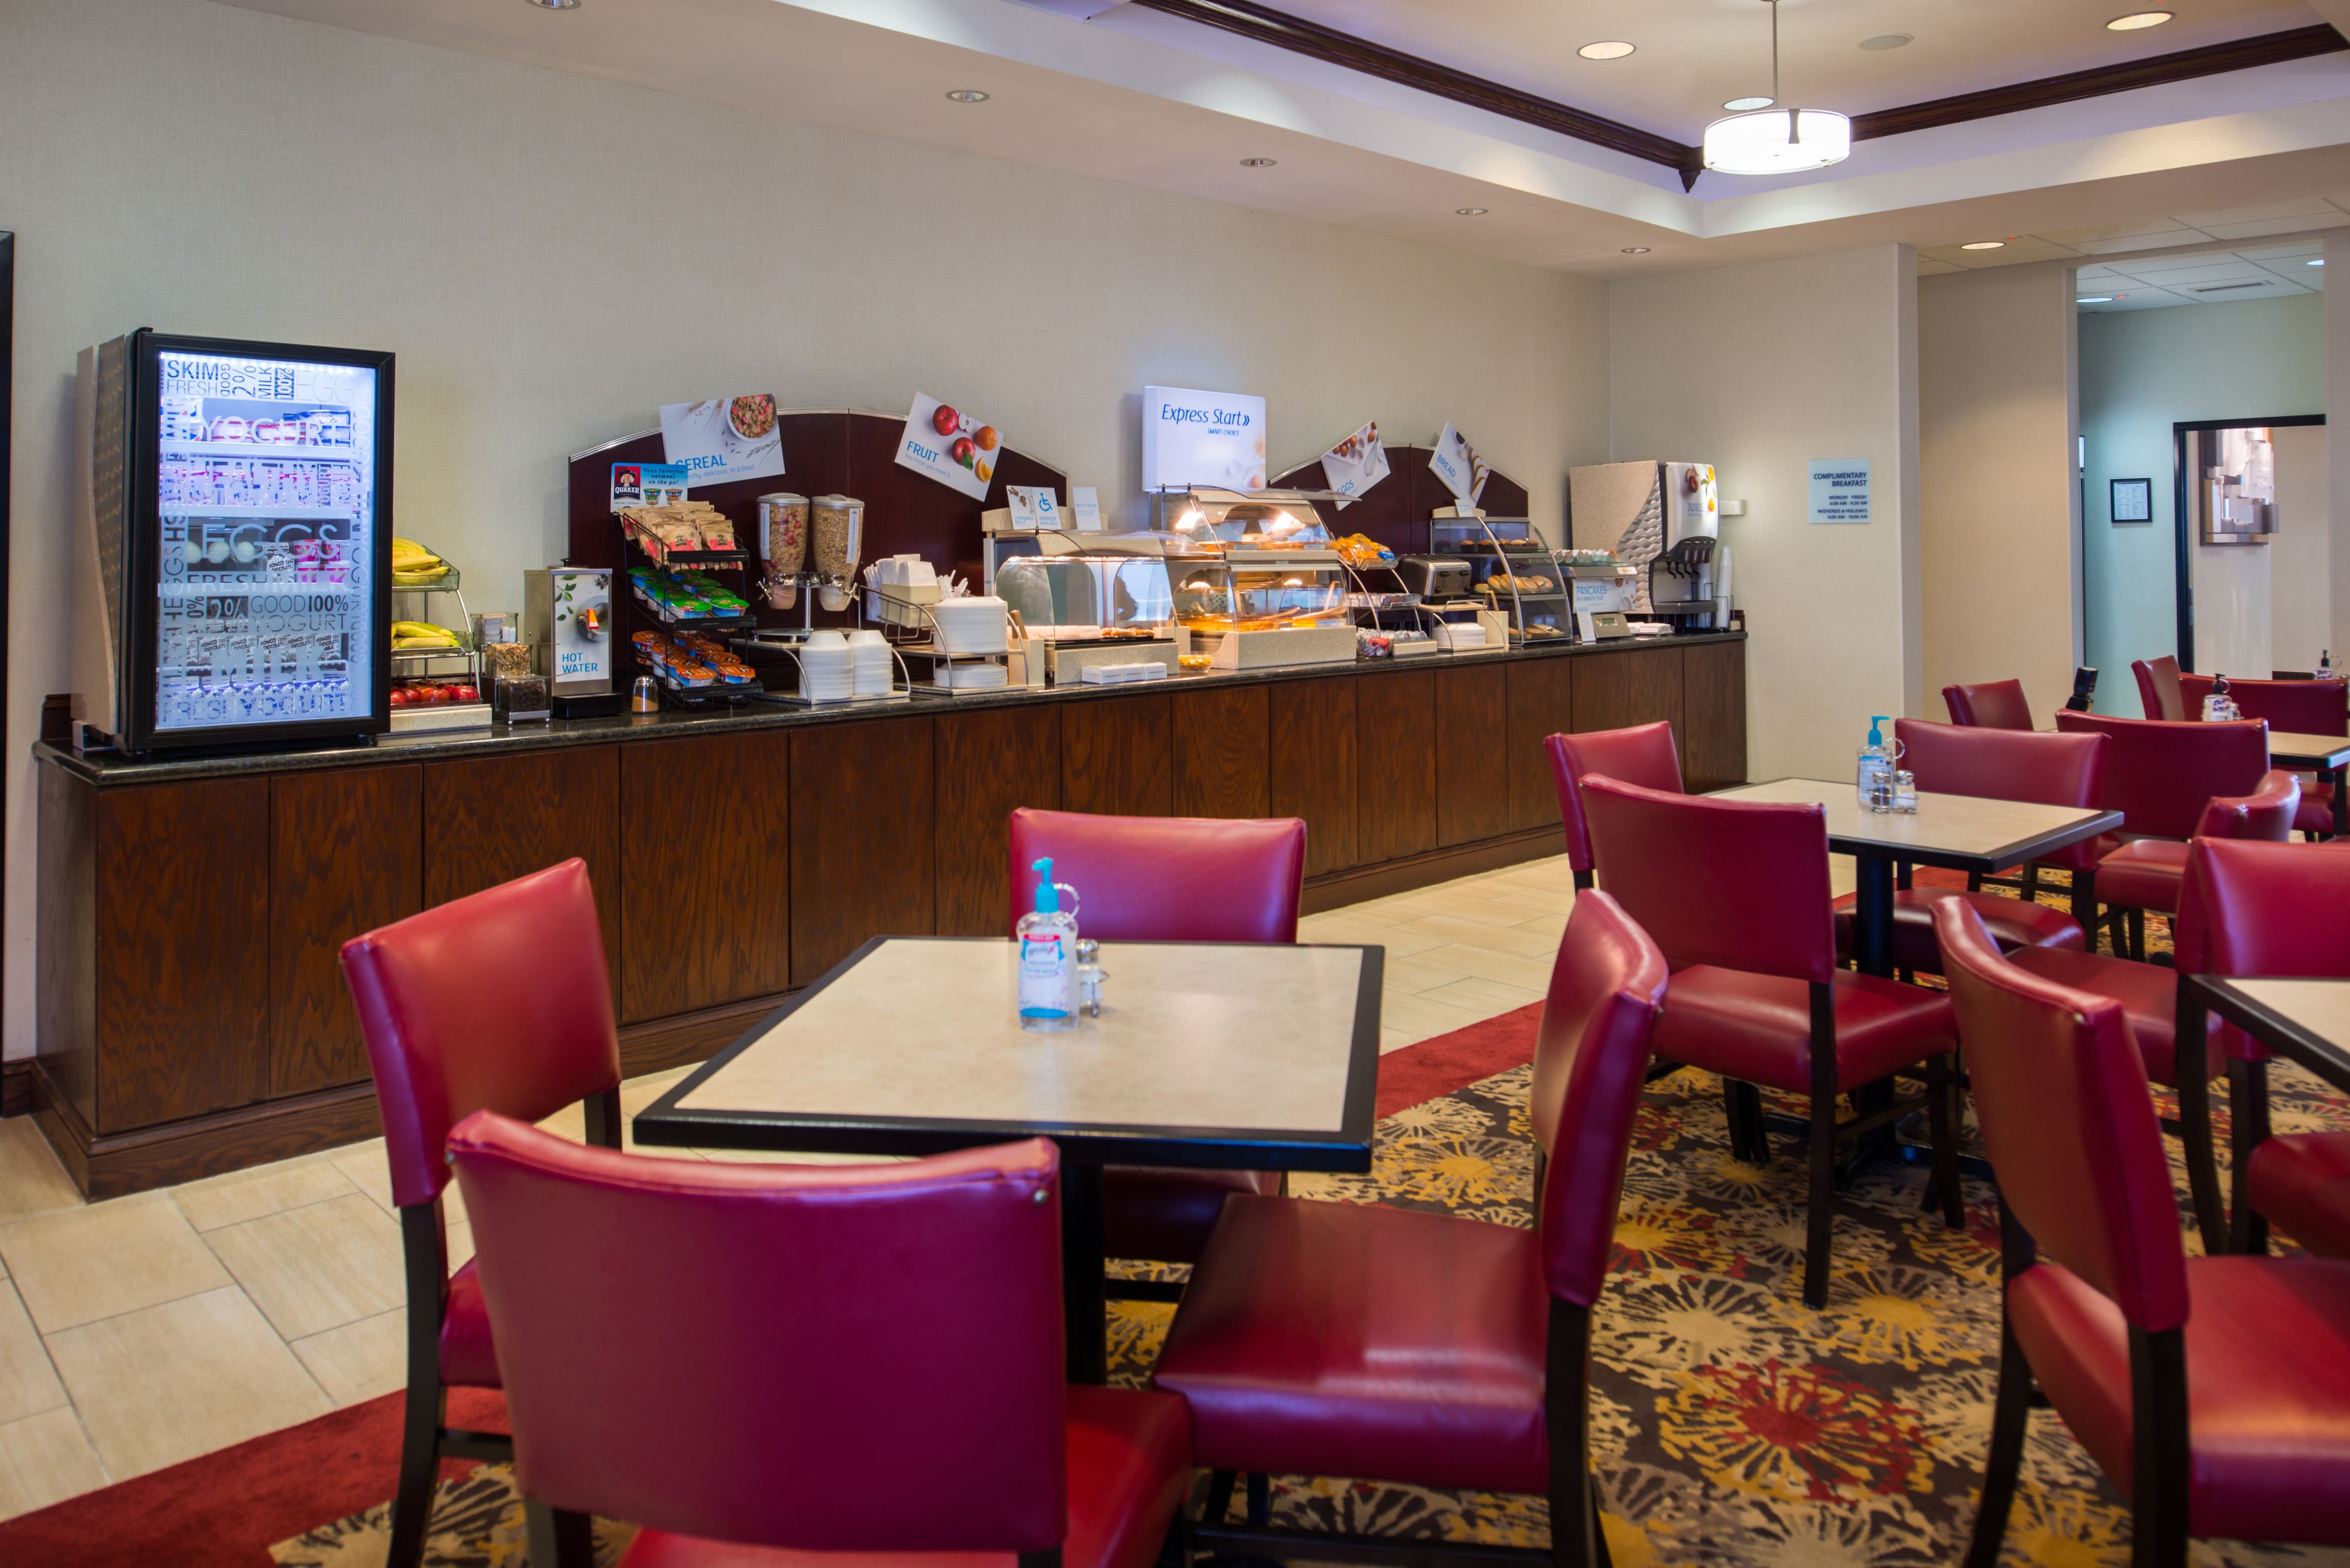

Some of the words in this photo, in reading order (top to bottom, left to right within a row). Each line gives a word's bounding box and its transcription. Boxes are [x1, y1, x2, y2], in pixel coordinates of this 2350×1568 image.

[167, 360, 218, 381] SKIM
[220, 364, 231, 397] GOOD
[232, 365, 256, 398] 2%
[166, 379, 218, 397] FRESH
[258, 367, 272, 399] MILK
[277, 367, 294, 400] 100%
[297, 370, 371, 405] EGGS
[1162, 404, 1209, 425] Express
[1212, 409, 1242, 426] Start
[201, 416, 345, 446] YOGURT
[907, 441, 939, 463] FRUIT
[190, 460, 316, 491] HEALTHY
[1438, 454, 1456, 477] BREAD
[1688, 503, 1704, 512] JUICE
[203, 524, 338, 559] EGGS
[164, 546, 184, 608] EGGS
[187, 574, 267, 592] FRESH
[272, 572, 349, 592] MILK
[1576, 586, 1606, 594] PANCAKES
[251, 595, 305, 613] GOOD
[308, 595, 348, 612] 100%
[252, 614, 347, 632] YOGURT
[562, 652, 583, 662] HOT
[562, 663, 598, 673] WATER
